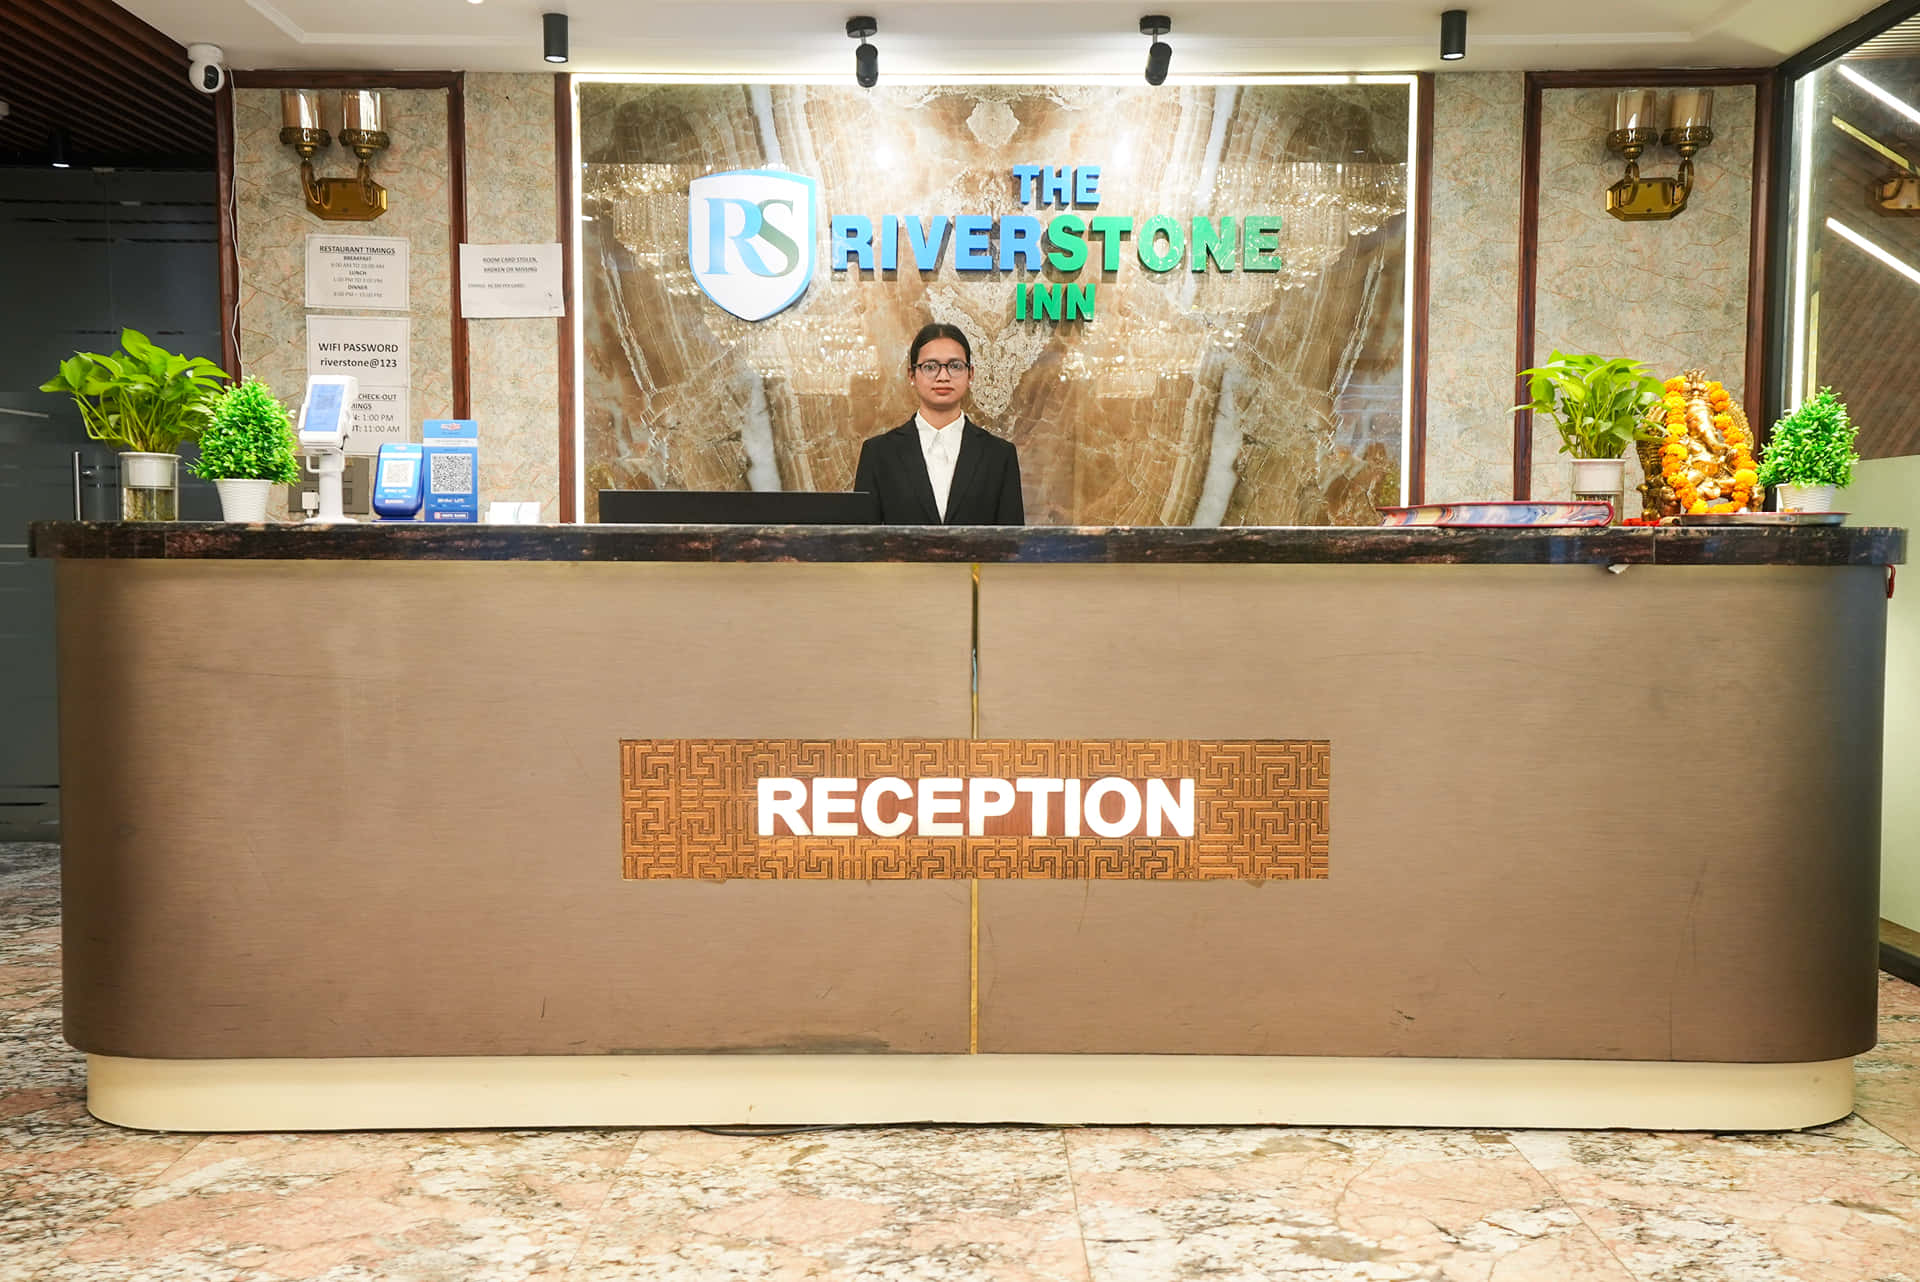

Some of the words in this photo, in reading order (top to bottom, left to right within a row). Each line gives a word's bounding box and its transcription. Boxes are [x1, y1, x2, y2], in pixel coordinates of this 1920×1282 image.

[1013, 165, 1100, 205] THE
[319, 245, 363, 254] RESTAURANT
[366, 247, 396, 255] TIMINGS
[703, 197, 800, 277] RS
[831, 213, 1282, 272] RIVERSTONE
[1016, 283, 1095, 321] INN
[318, 343, 341, 352] WIFI
[343, 343, 399, 352] PASSWORD
[320, 357, 398, 368] riverstone@123
[387, 425, 400, 433] AM
[757, 778, 1194, 837] RECEPTION
